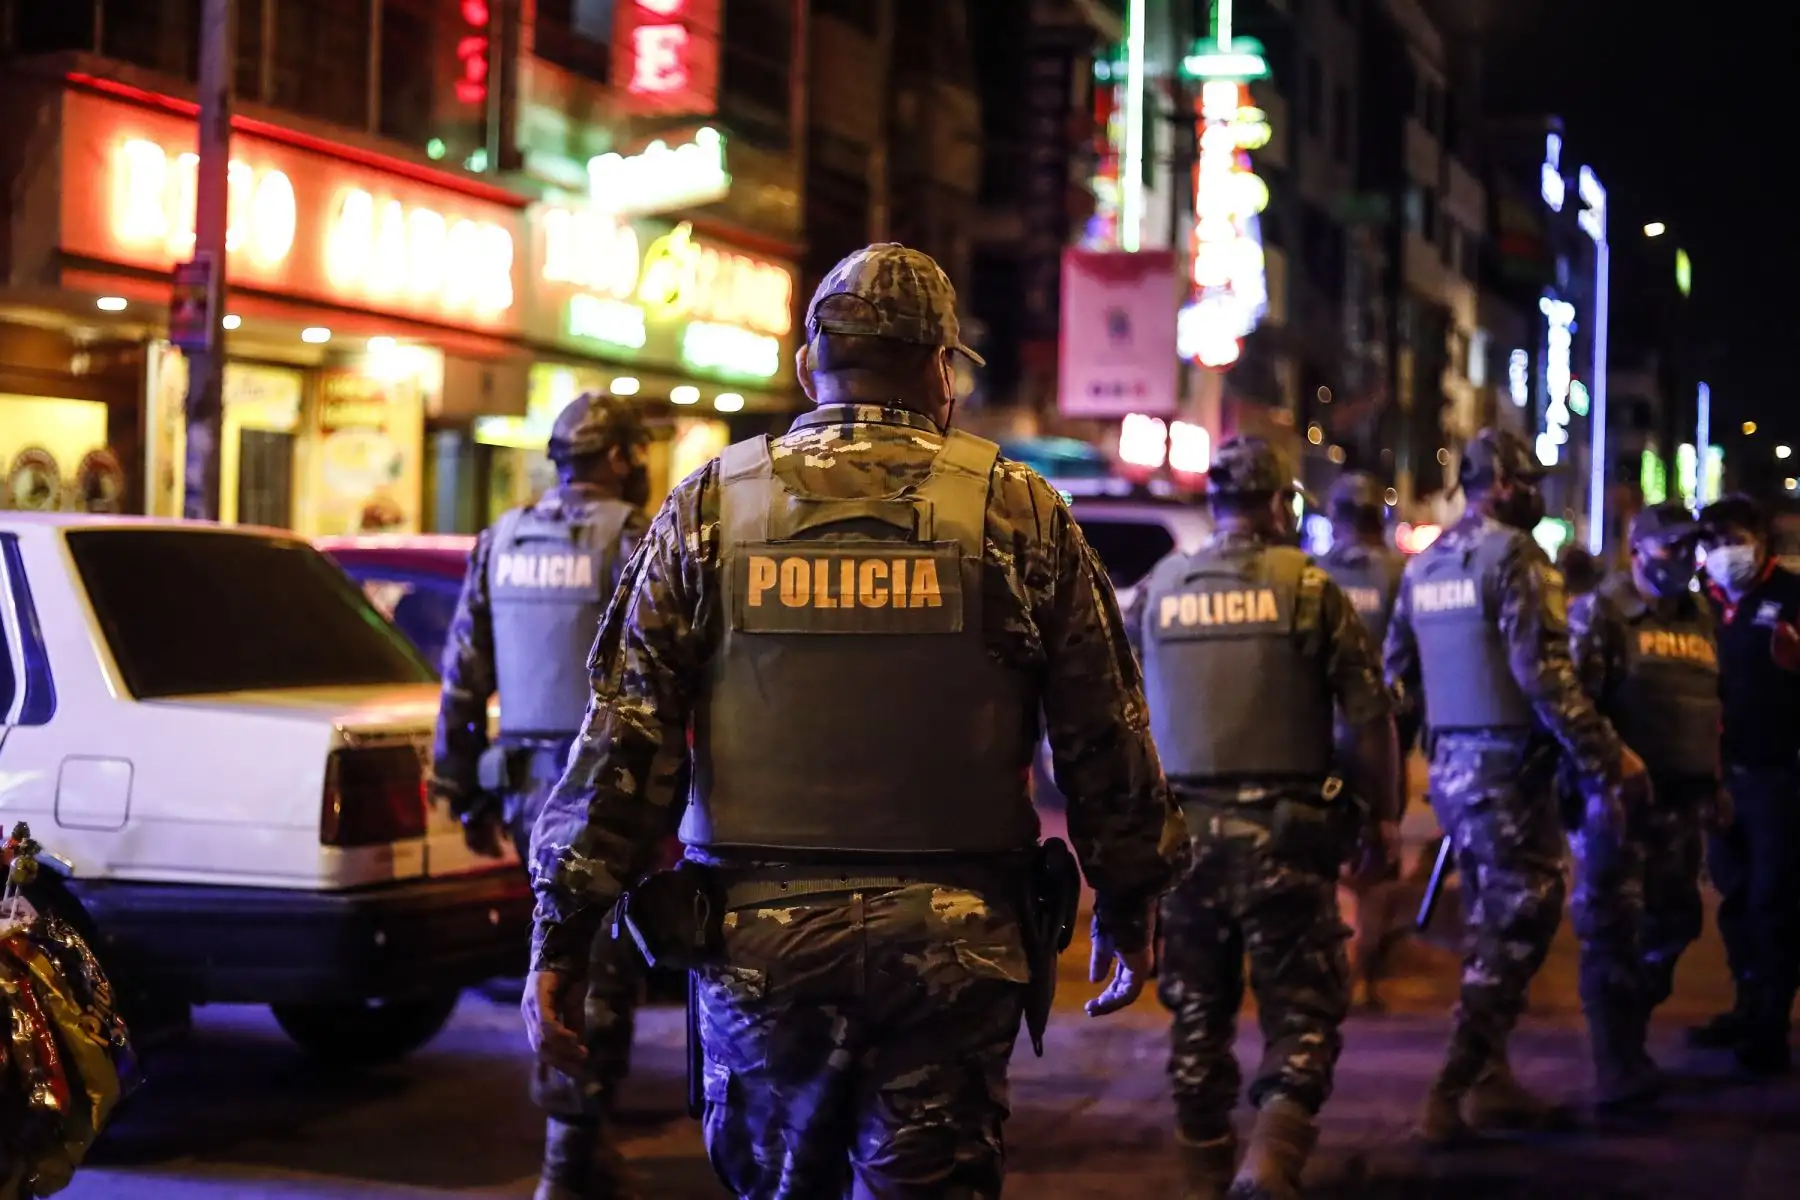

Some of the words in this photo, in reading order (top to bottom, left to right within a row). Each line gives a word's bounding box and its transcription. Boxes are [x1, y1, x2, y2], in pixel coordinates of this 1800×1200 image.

[495, 553, 592, 587] POLICIA
[748, 556, 942, 608] POLICIA
[1160, 588, 1278, 628] POLICIA
